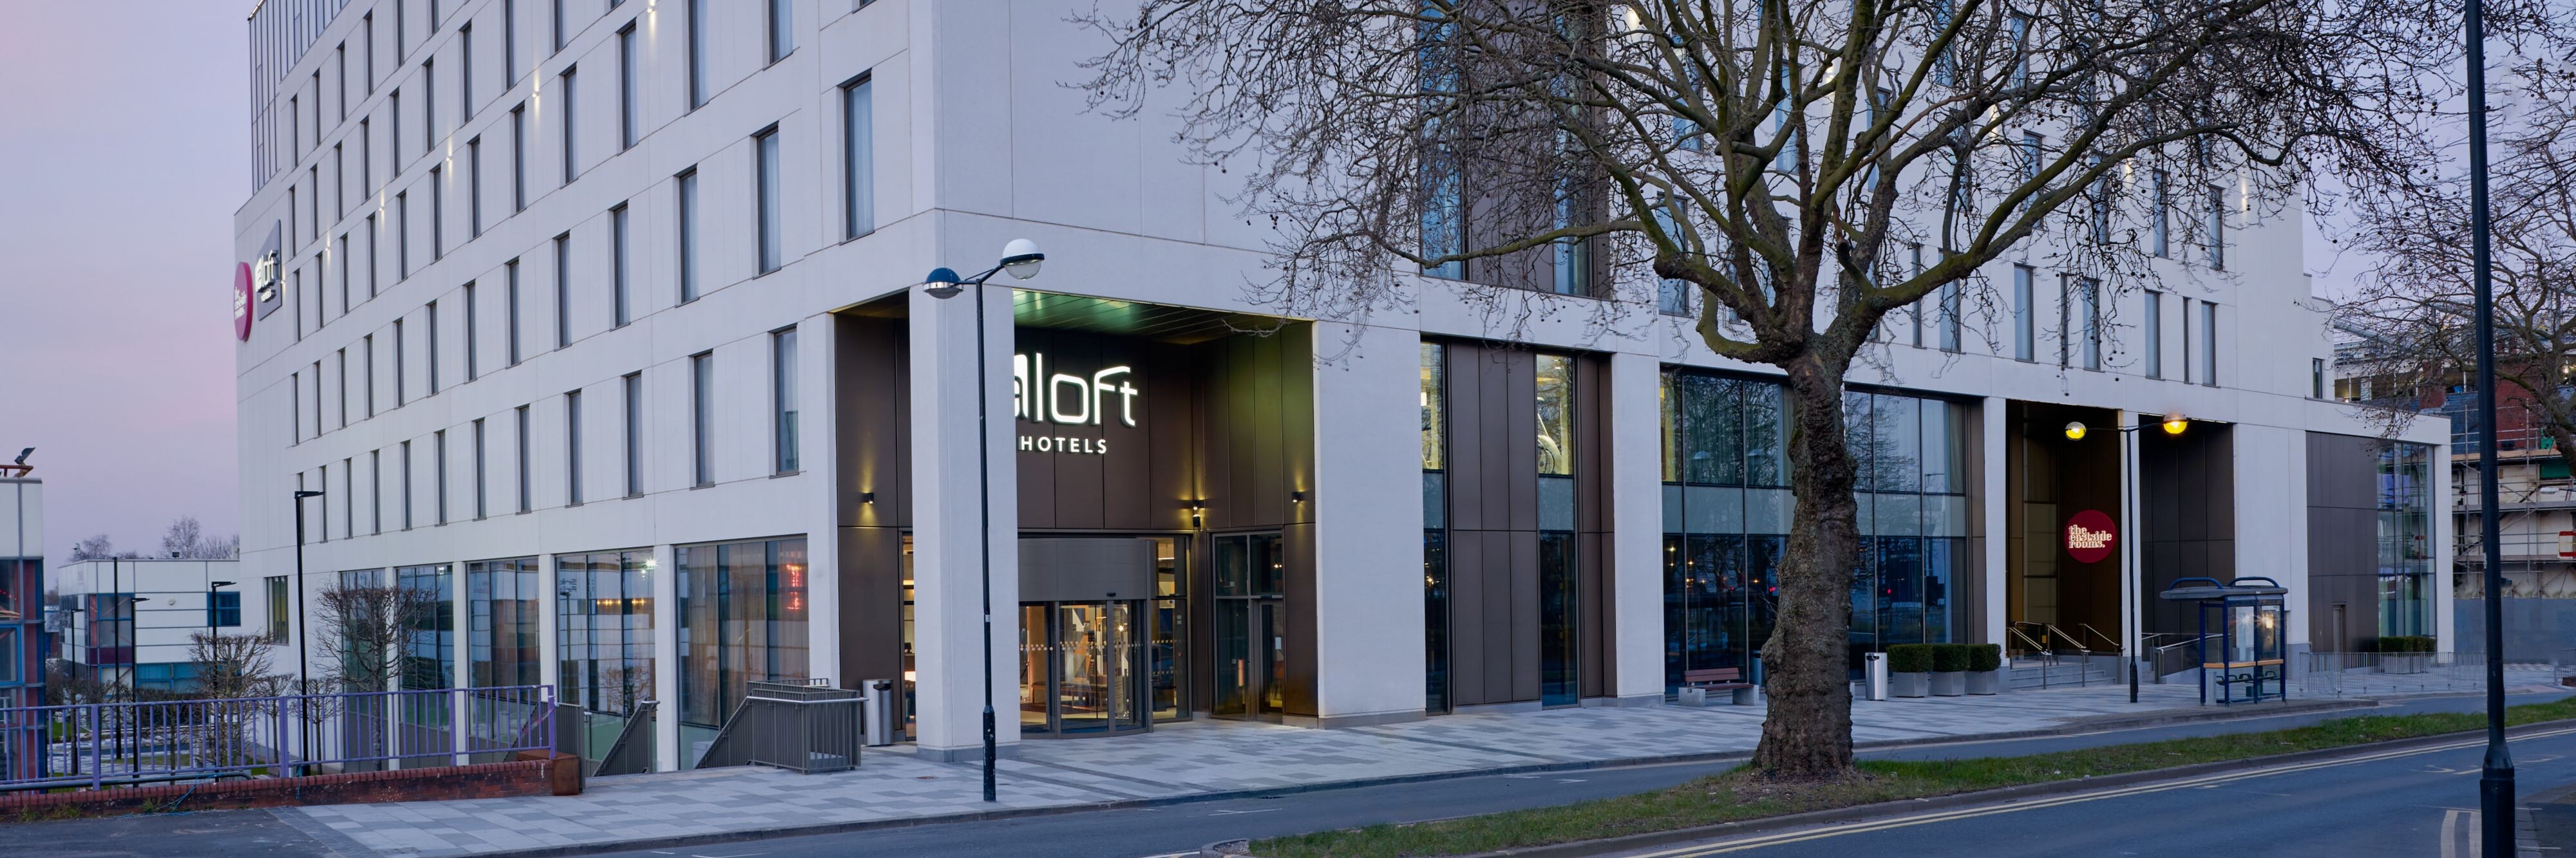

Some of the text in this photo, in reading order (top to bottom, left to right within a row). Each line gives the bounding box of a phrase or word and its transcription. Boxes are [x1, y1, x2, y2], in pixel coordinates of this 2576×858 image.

[1019, 436, 1106, 454] HOTELS
[2069, 524, 2087, 535] the
[2069, 530, 2112, 541] eastside
